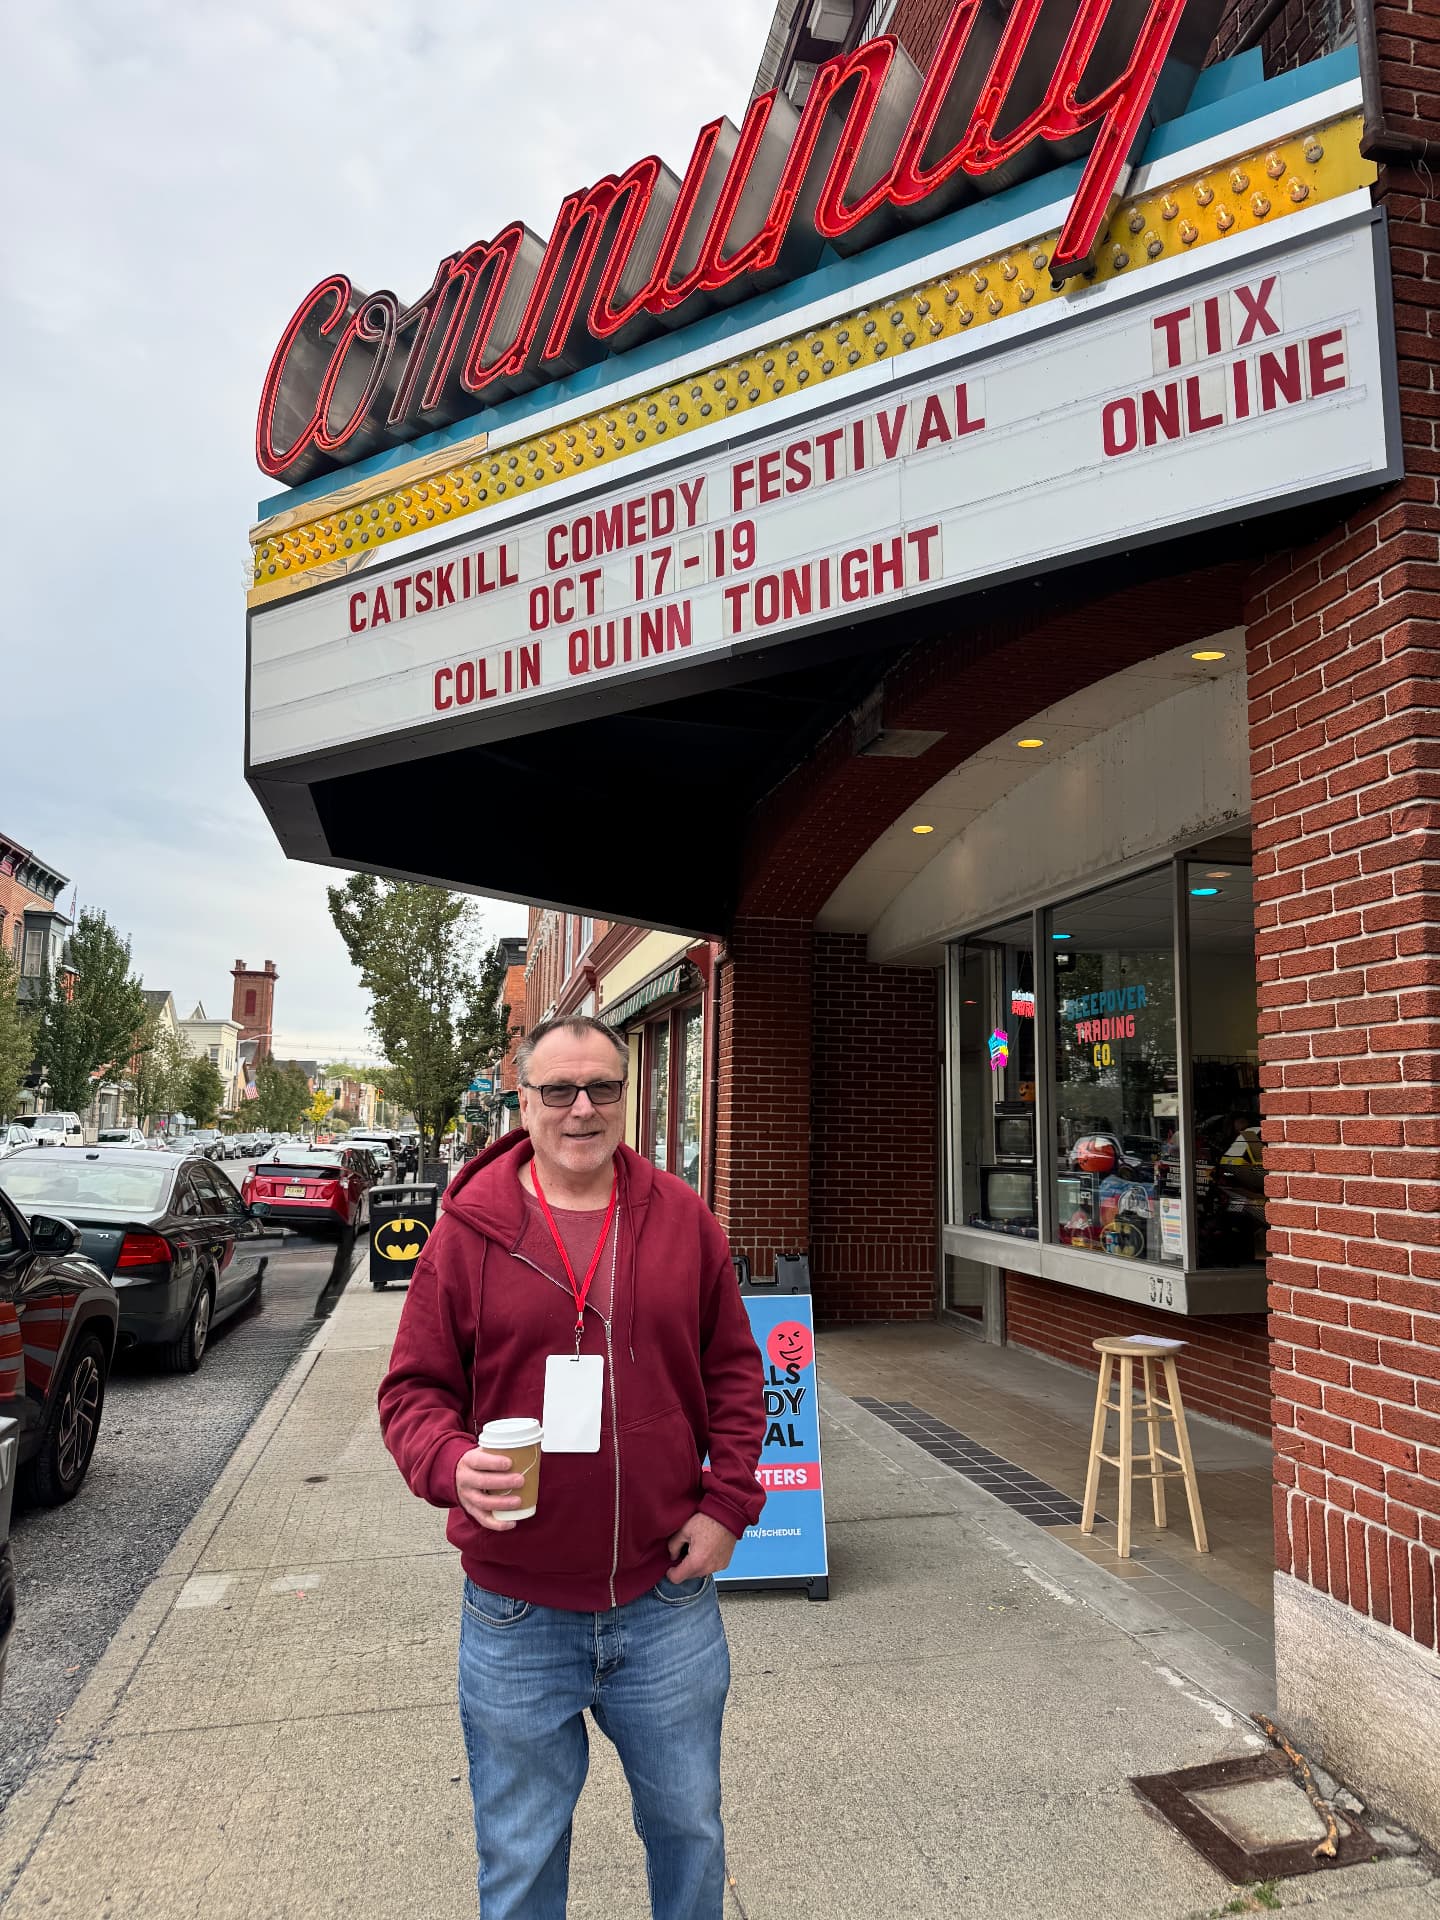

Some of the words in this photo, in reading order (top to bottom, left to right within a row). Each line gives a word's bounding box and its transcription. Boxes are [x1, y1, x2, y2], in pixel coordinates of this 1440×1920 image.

[256, 0, 1187, 475] Community
[1154, 277, 1278, 367] TIX
[1102, 330, 1345, 456] ONLINE
[349, 545, 518, 633] CATSKILL
[547, 477, 704, 570] COMEDY
[733, 383, 985, 512] FESTIVAL
[434, 643, 541, 711] COLIN
[568, 600, 691, 676] QUINN
[724, 526, 938, 633] TONIGHT
[529, 569, 602, 631] OCT
[635, 520, 756, 601] 17-19
[1066, 985, 1147, 1021] SLEEPOVER
[1076, 1015, 1135, 1044] TRADING
[1093, 1043, 1115, 1067] CO.
[764, 1363, 801, 1386] LS
[746, 1528, 802, 1539] TIX/SCHEDULE
